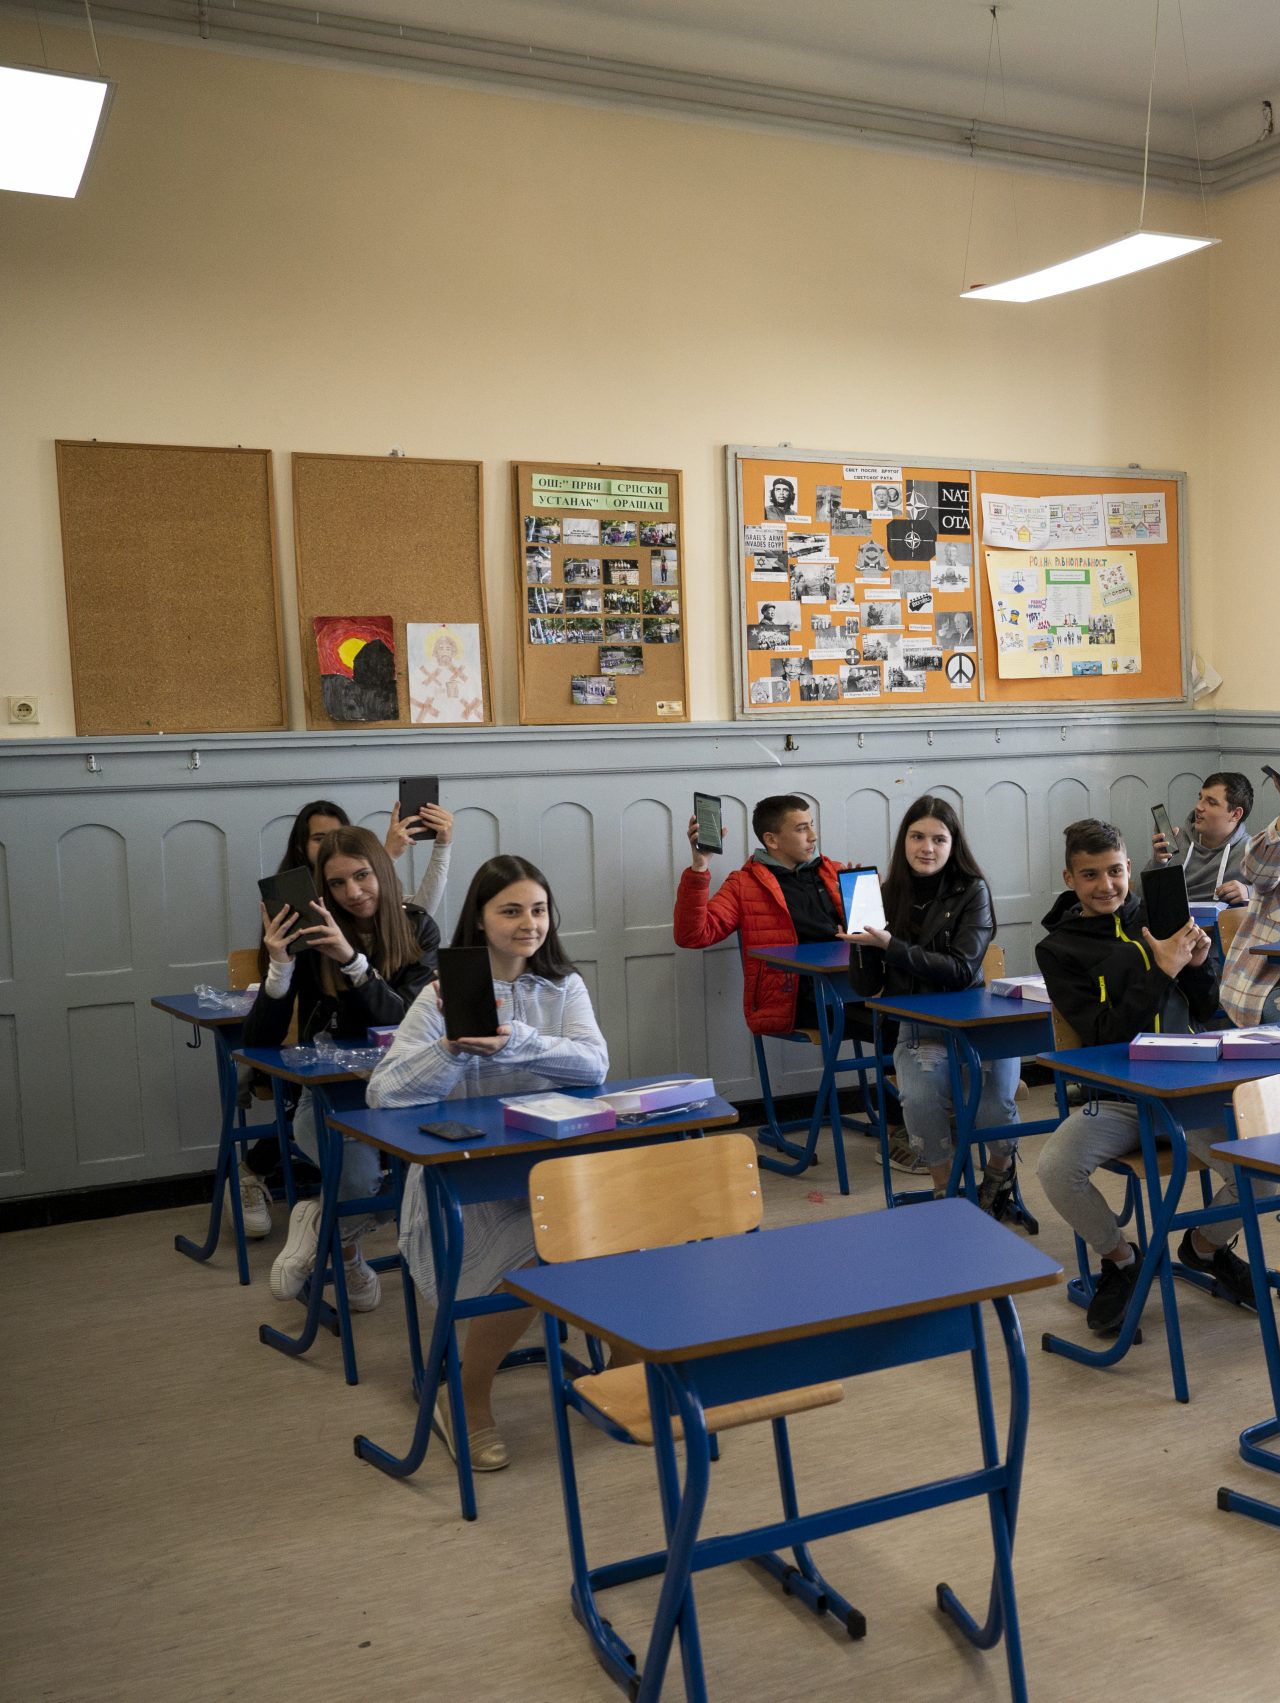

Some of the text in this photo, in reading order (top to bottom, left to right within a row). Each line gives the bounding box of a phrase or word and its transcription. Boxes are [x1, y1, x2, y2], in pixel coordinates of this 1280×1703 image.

[571, 479, 601, 491] ПРВИ
[617, 483, 663, 495] СРПСКИ
[613, 499, 663, 511] ОРАШАЦ
